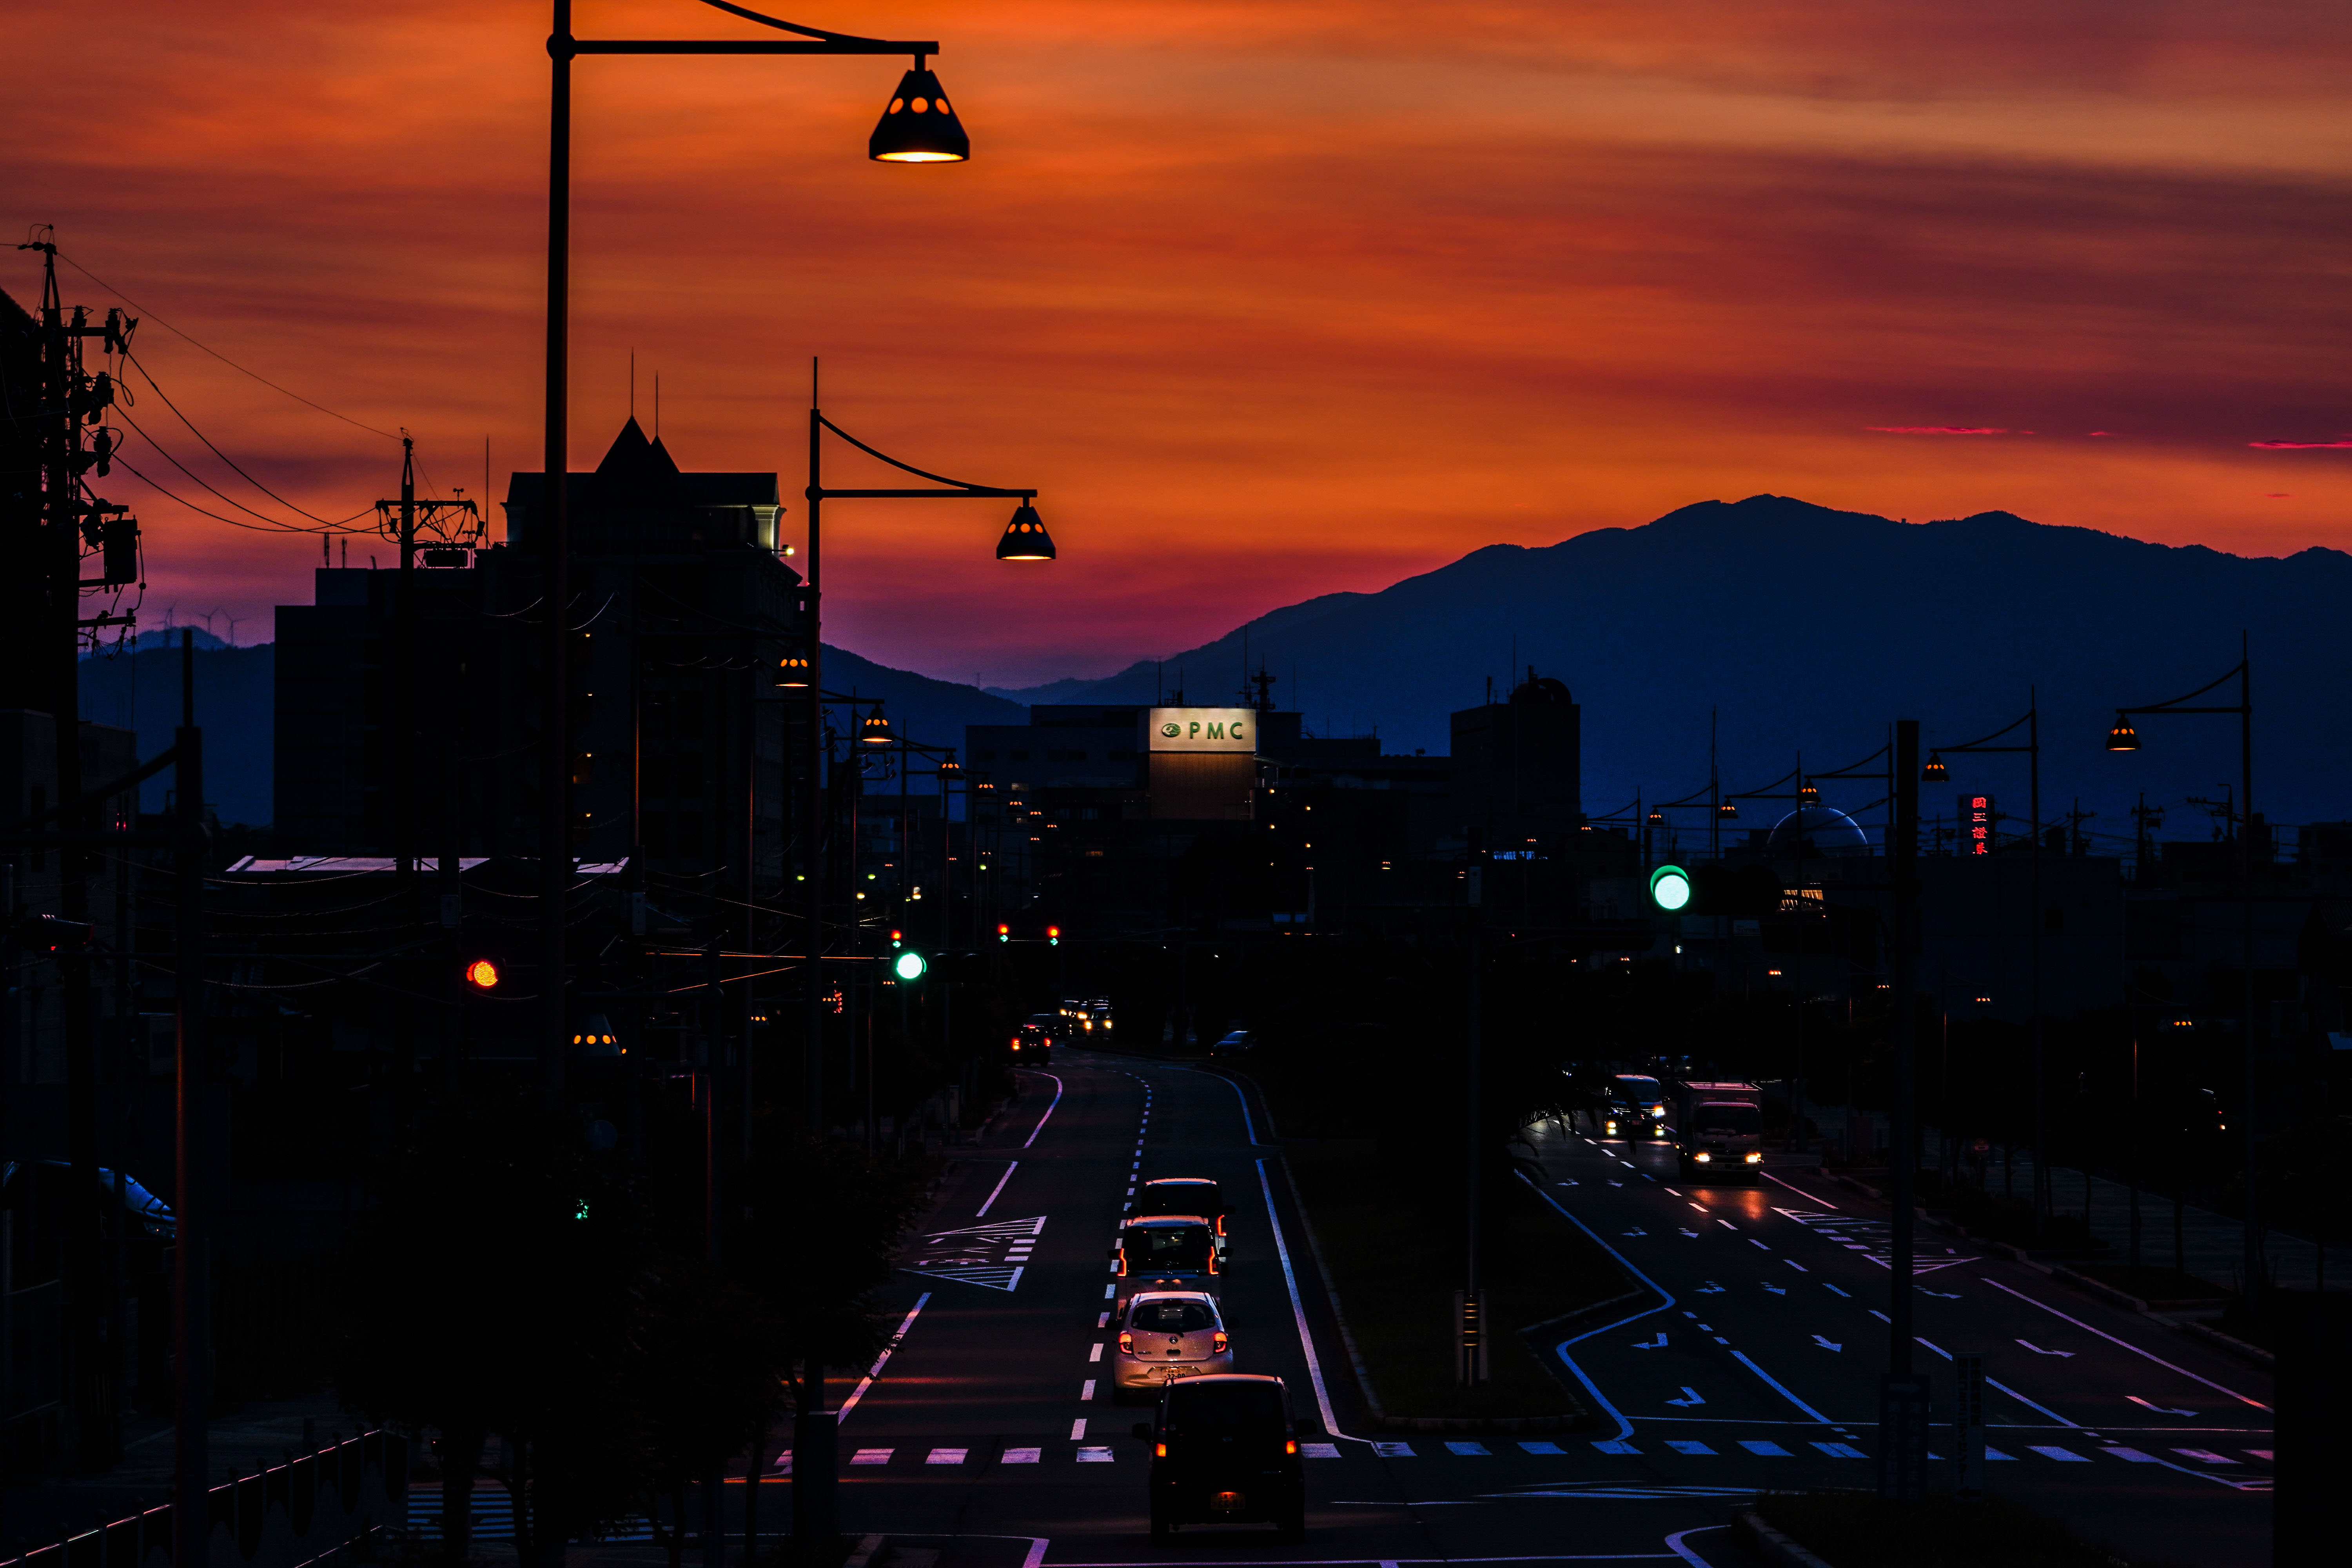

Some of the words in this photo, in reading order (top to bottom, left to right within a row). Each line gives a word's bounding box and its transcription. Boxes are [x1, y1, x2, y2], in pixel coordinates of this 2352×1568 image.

[1190, 722, 1243, 739] PMC
[1905, 1401, 1923, 1500] 津なぎさまち
